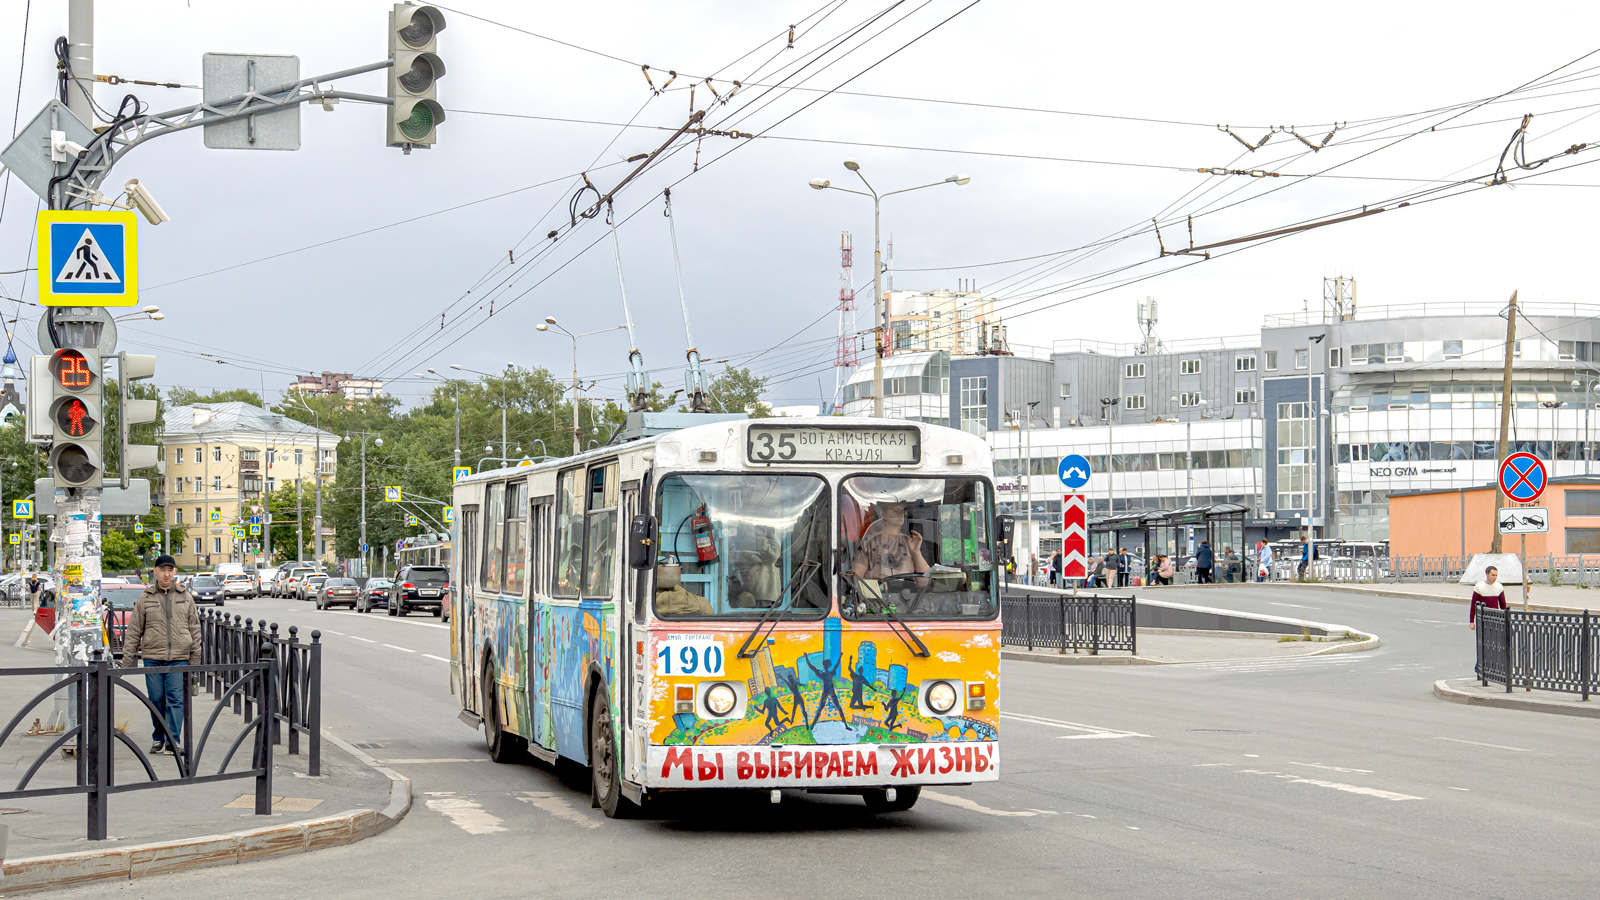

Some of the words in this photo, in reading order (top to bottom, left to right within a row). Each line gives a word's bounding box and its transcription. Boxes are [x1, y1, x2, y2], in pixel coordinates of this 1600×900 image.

[61, 356, 90, 387] 25
[756, 432, 797, 460] 35
[799, 432, 907, 446] БОТАНИЧЕСКАЯ
[825, 448, 883, 461] КРАУЛЯ
[1370, 467, 1392, 477] NEO
[1394, 466, 1418, 476] GYM
[658, 645, 722, 674] 190
[736, 750, 879, 780] ВЫБИРАЕМ
[889, 743, 995, 778] ЖИЗНЬ!
